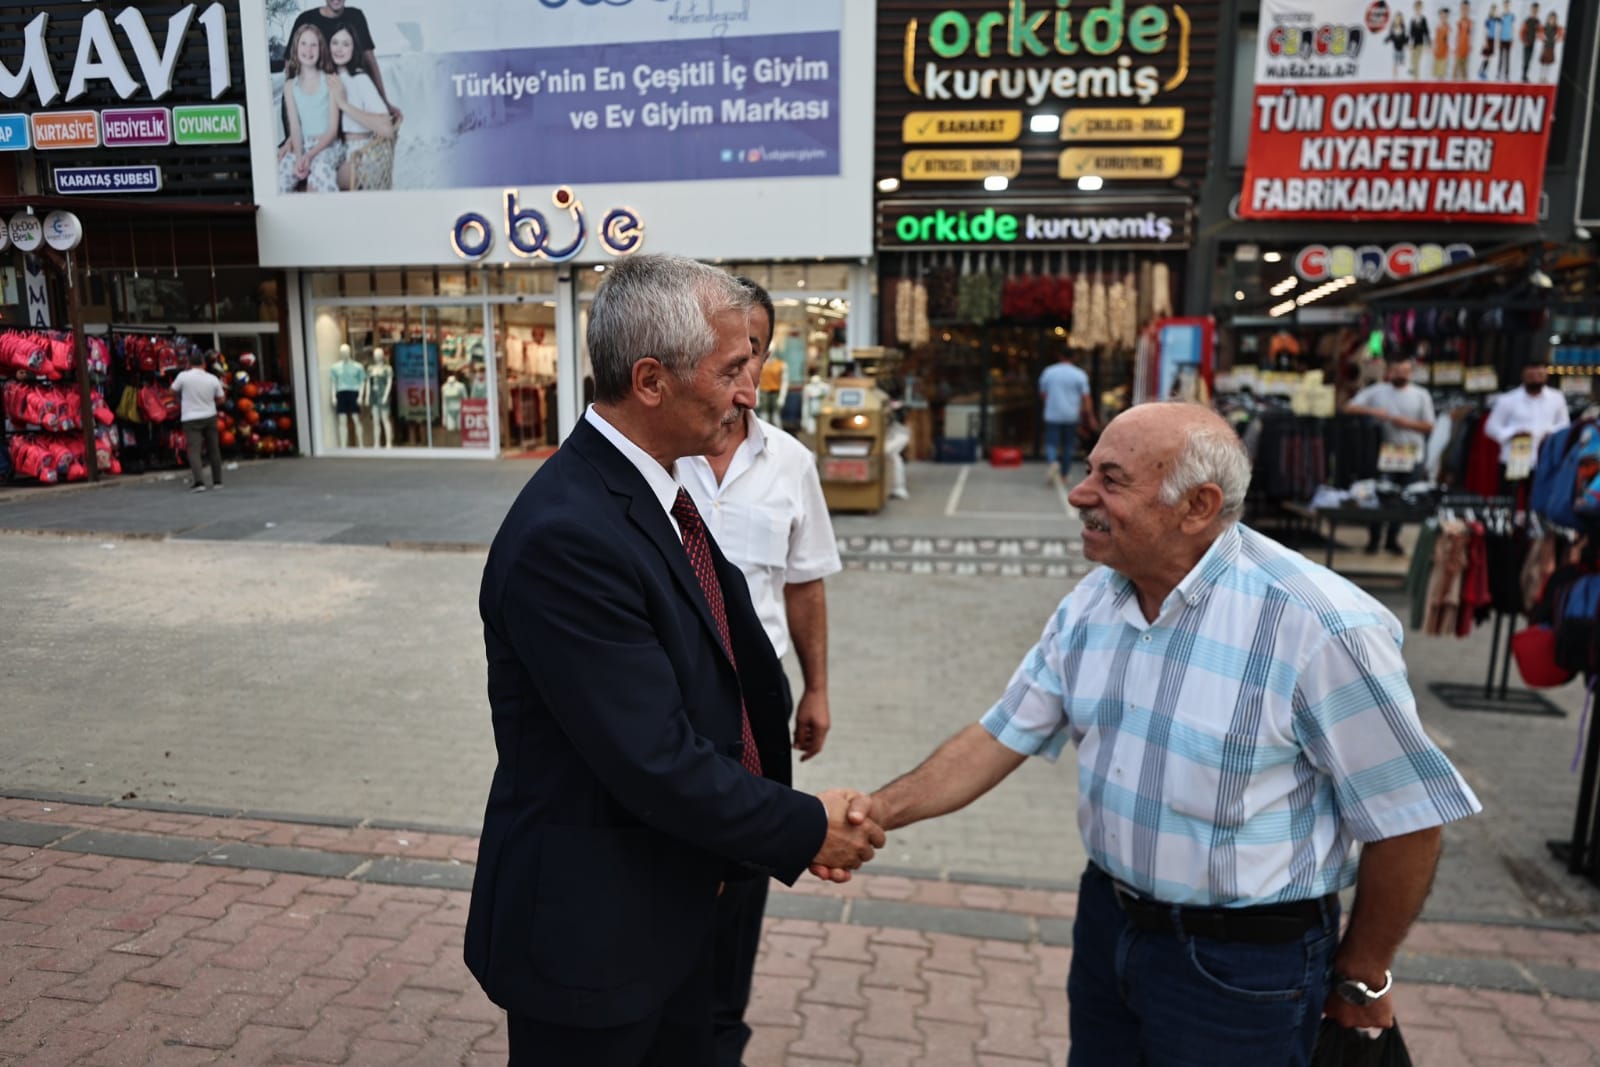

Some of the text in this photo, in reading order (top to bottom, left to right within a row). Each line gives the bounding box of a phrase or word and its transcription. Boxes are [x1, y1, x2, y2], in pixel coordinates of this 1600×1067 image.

[929, 0, 1168, 58] orkide
[452, 55, 829, 100] Türkiye'nin En Çeşitli İç Giyim
[925, 55, 1159, 105] kuruyemiş
[106, 117, 165, 138] HEDİYELİK
[179, 115, 237, 134] OYUNCAK
[569, 97, 829, 131] ve Ev Giyim Markası
[1257, 88, 1546, 132] TÜM OKULUNUZUN
[36, 119, 94, 141] KIRTASİYE
[60, 170, 154, 188] KARATAŞ ŞUBESİ
[1434, 179, 1526, 215] HALKA
[896, 208, 1173, 243] orkide kuruyemiş
